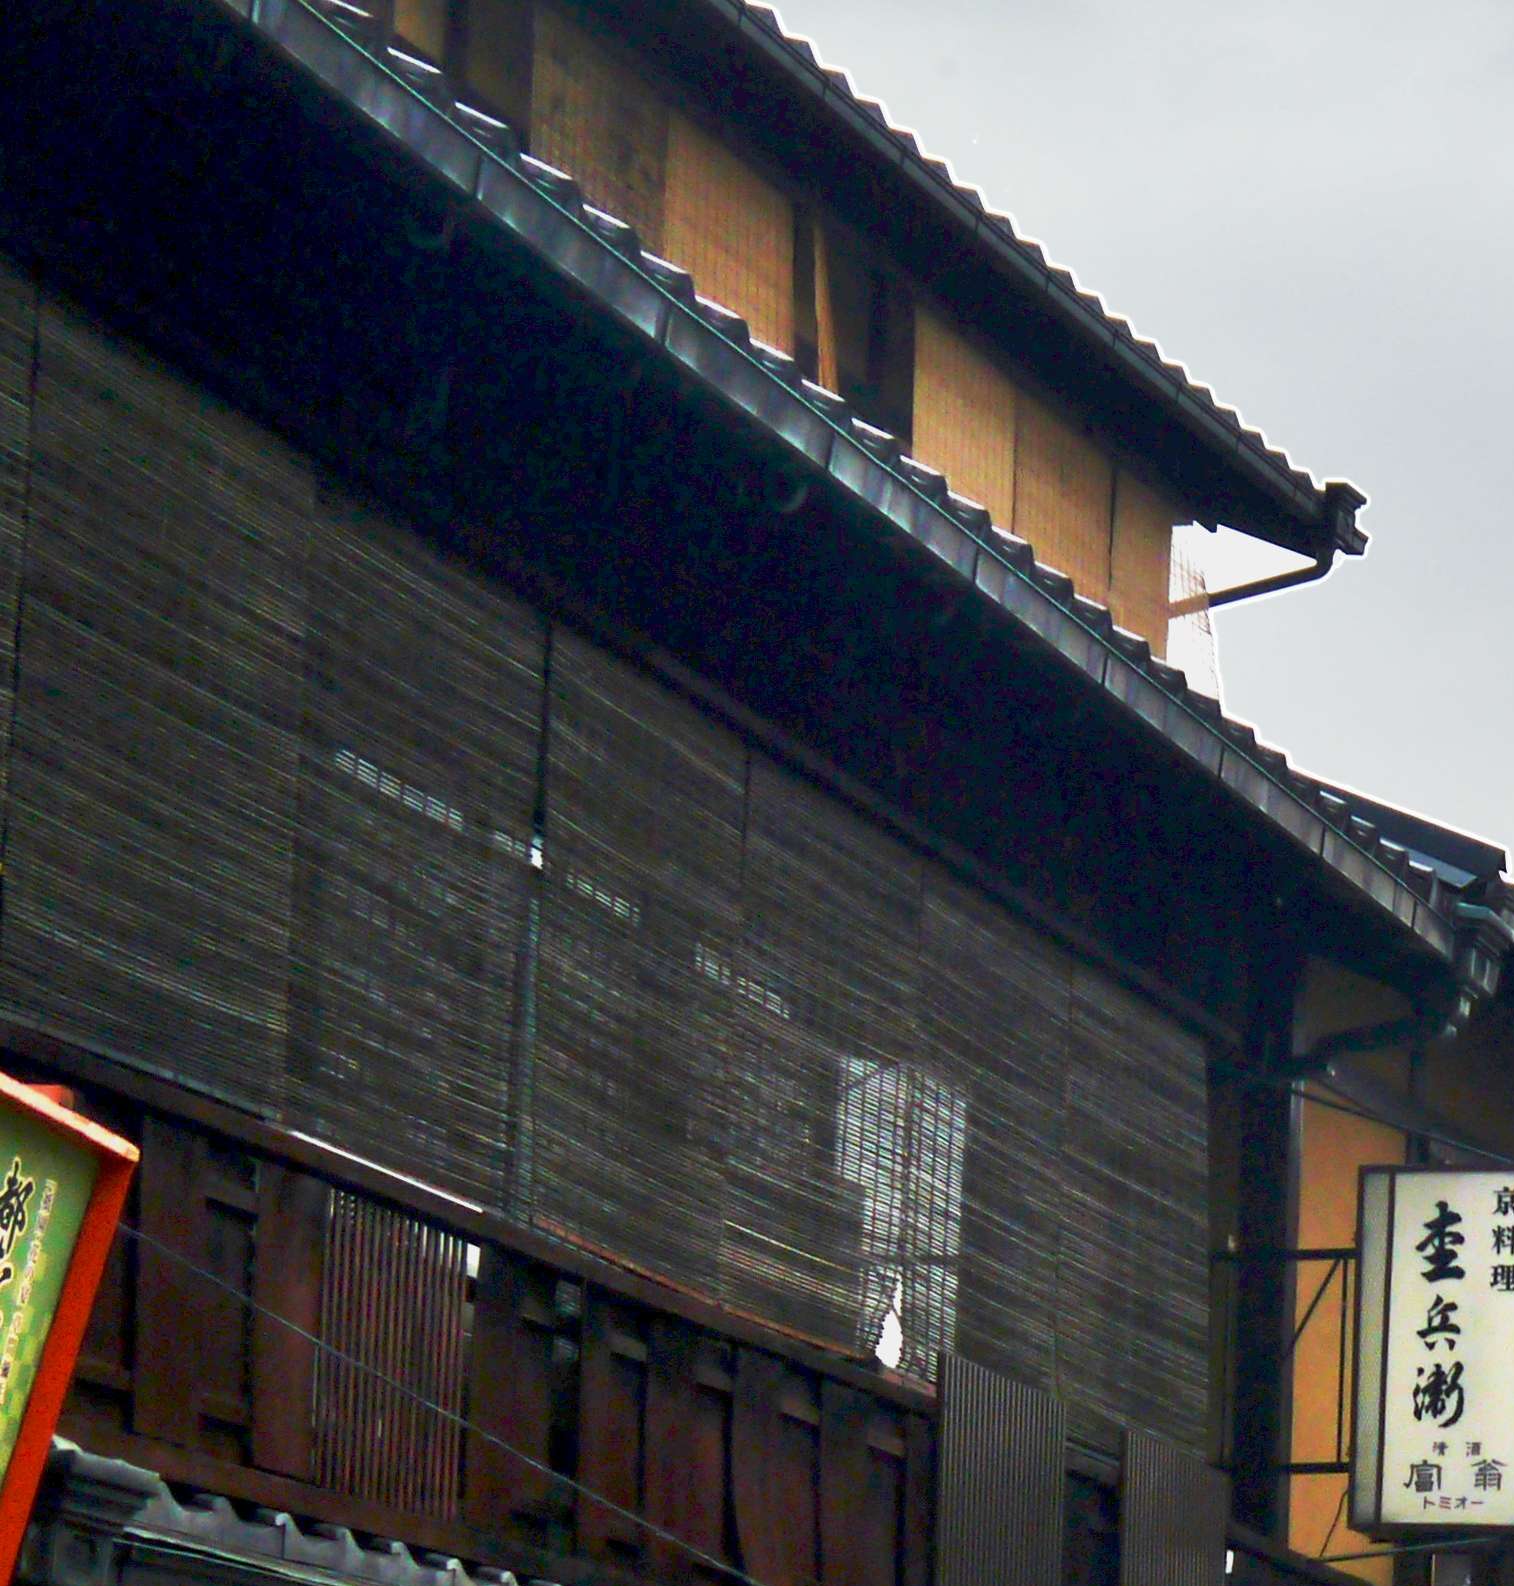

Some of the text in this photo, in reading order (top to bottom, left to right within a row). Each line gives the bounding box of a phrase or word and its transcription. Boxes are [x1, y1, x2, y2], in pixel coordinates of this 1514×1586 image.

[1403, 1458, 1509, 1493] 富翁
[1422, 1495, 1485, 1510] トミオー
